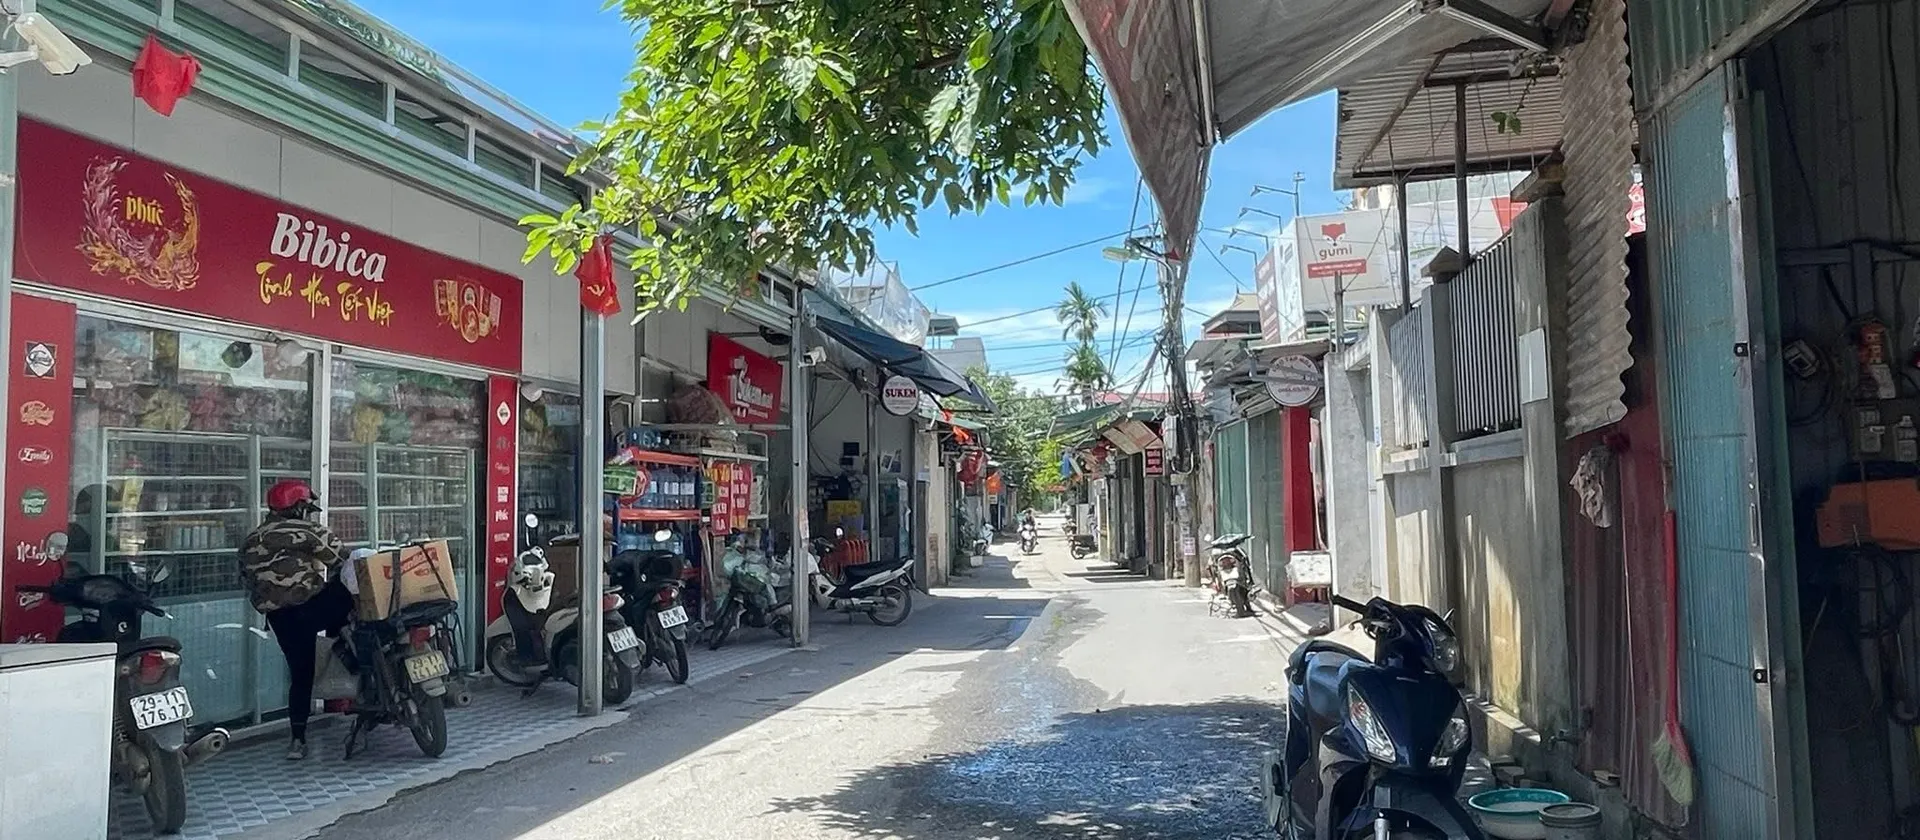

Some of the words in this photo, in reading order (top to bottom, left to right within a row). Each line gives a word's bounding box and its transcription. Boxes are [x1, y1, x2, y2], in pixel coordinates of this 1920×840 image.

[270, 212, 387, 283] Bibica
[1318, 245, 1353, 261] gumi
[365, 287, 396, 328] Việt
[885, 387, 917, 398] SUKEM
[139, 691, 180, 712] 29-T1
[140, 704, 186, 726] 176.17
